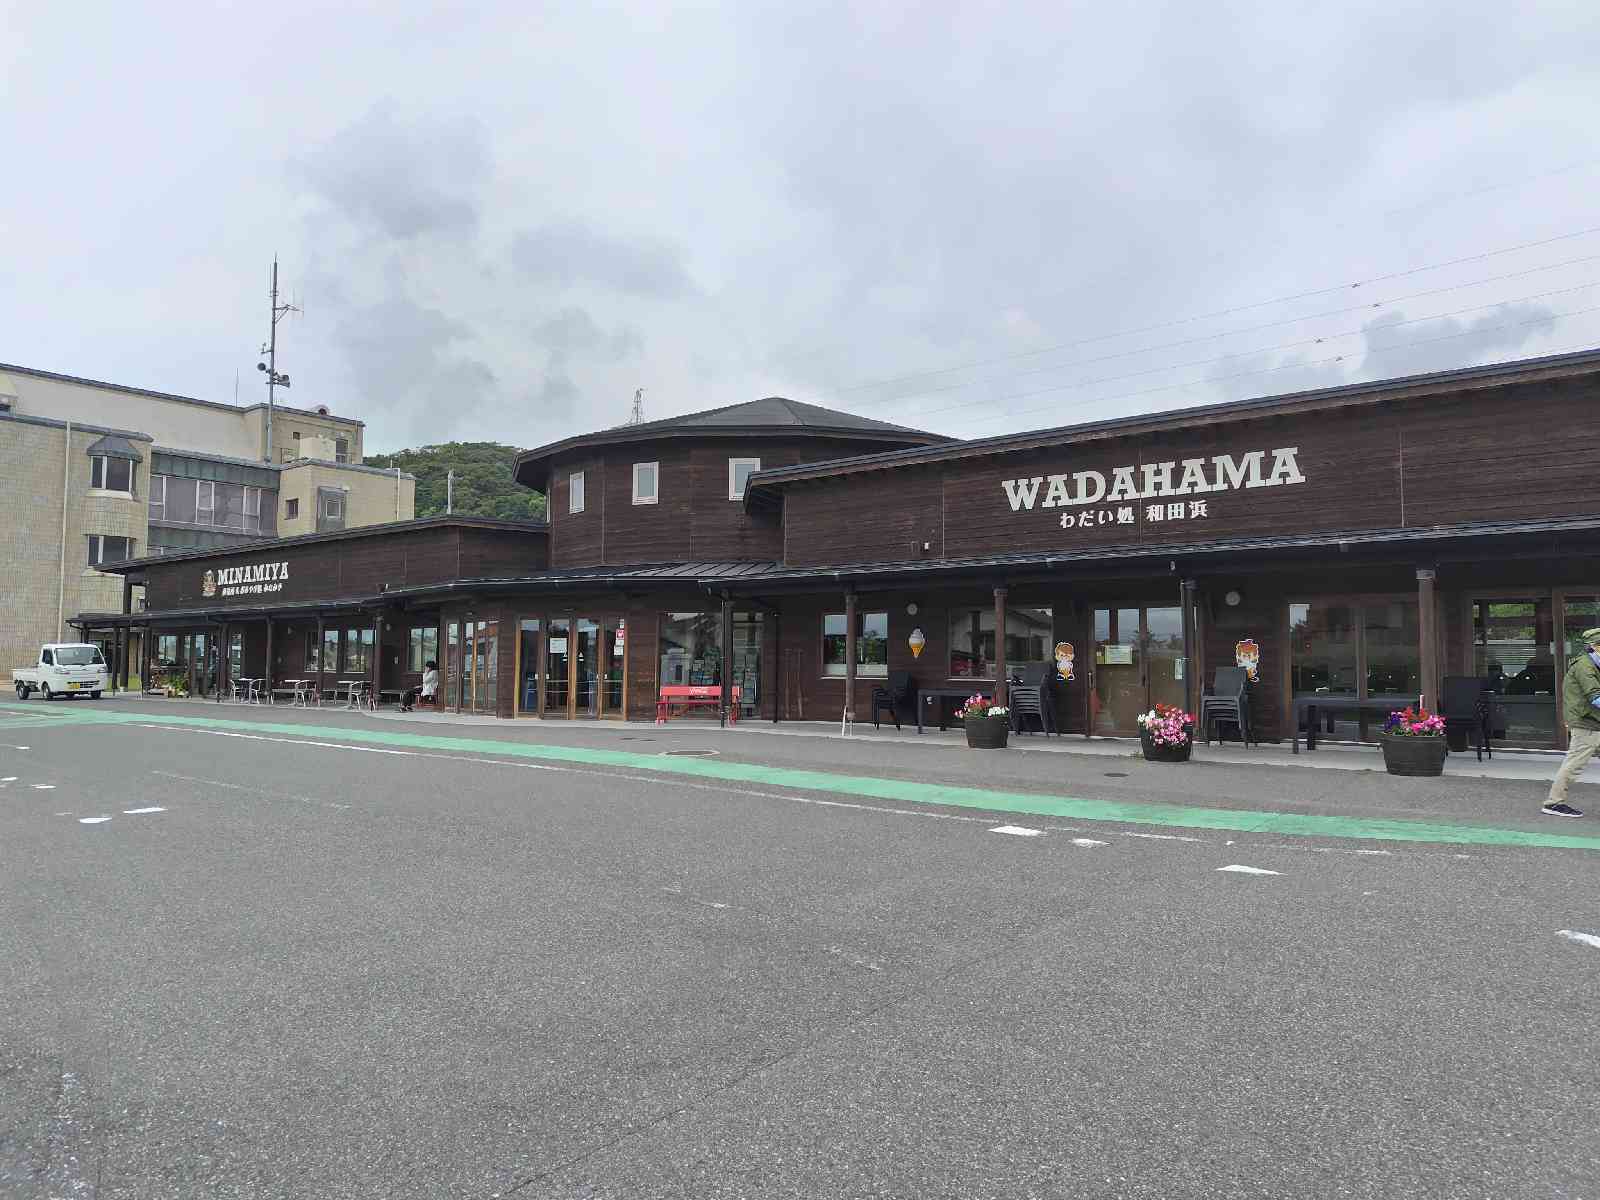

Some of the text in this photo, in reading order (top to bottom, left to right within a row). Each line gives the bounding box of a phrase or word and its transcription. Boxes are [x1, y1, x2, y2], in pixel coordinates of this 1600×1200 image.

[1001, 446, 1306, 512] WADAHAMA
[1059, 500, 1208, 529] わだい処 和田浜
[217, 561, 289, 586] MINAMIYA
